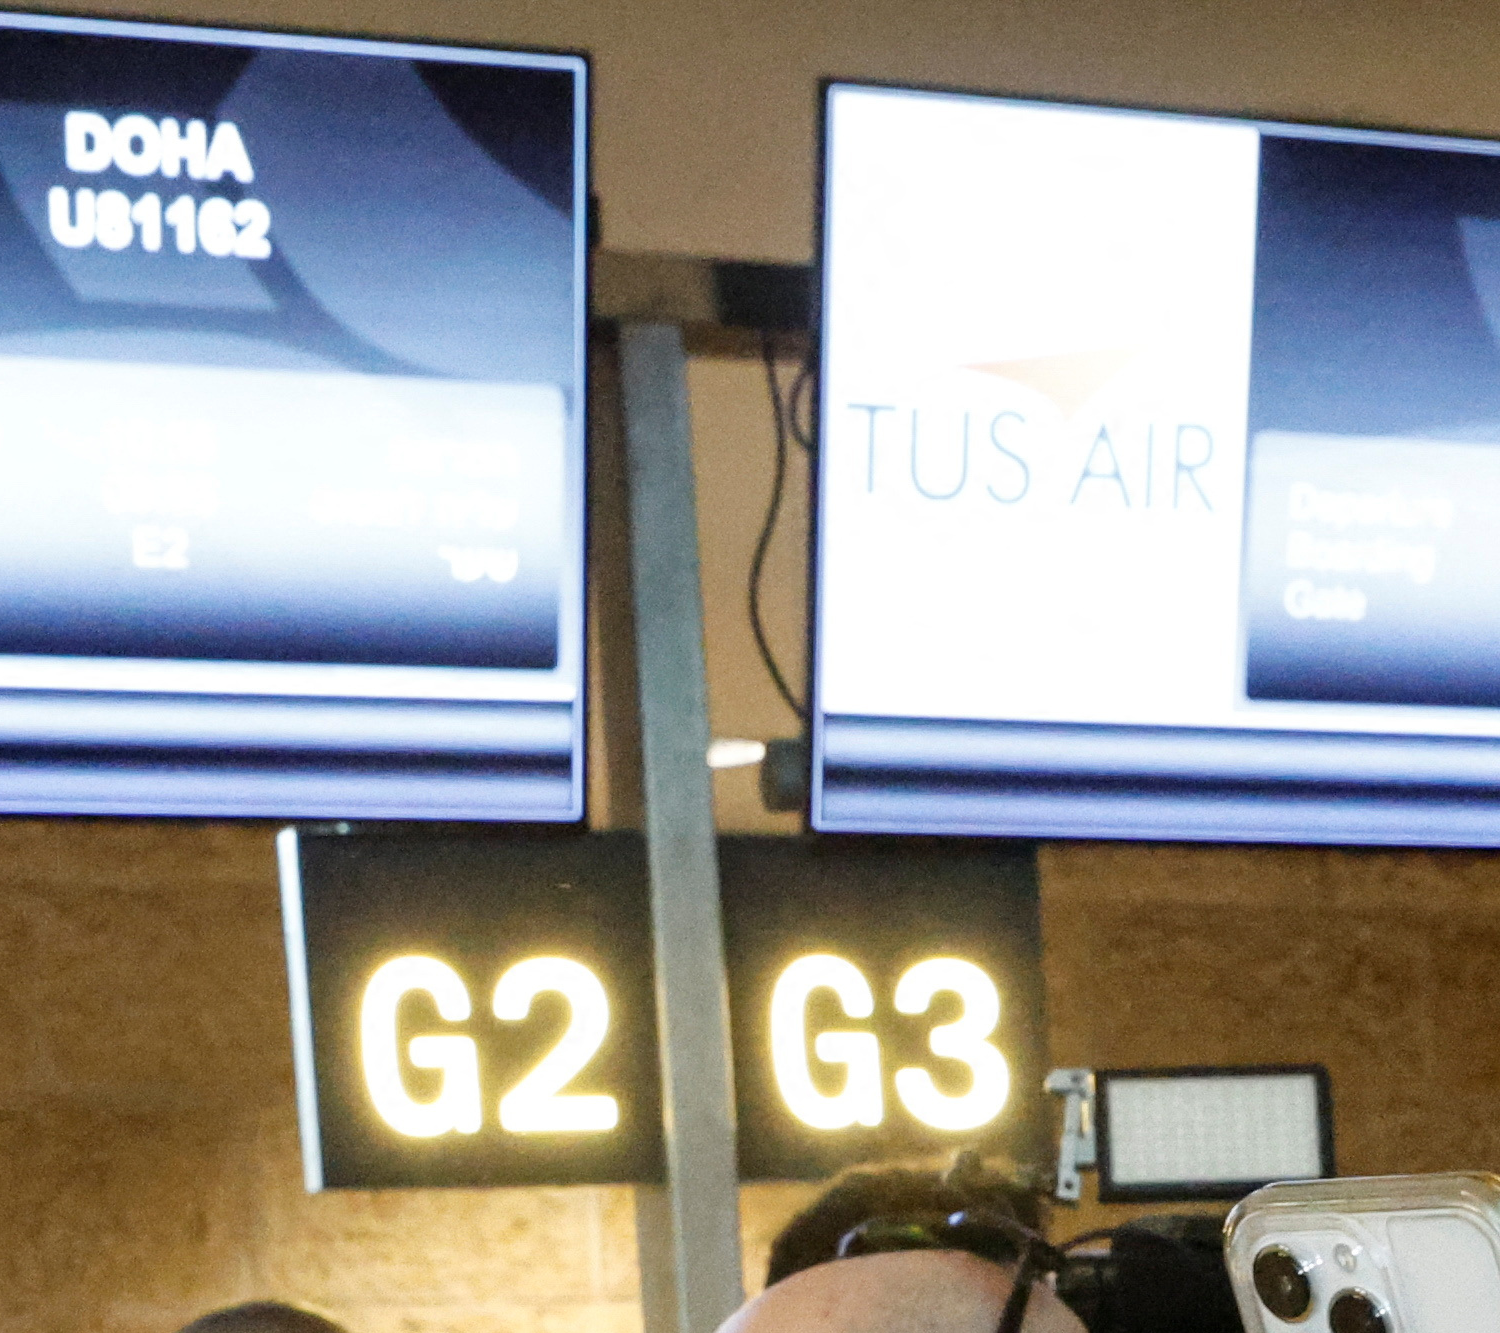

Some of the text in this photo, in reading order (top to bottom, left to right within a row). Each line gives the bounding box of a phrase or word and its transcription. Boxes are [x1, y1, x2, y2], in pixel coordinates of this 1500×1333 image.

[65, 112, 253, 182] DOHA
[48, 187, 271, 258] U81162
[845, 401, 1217, 516] TUS AIR
[357, 953, 620, 1139] G2
[768, 952, 1012, 1132] G3
